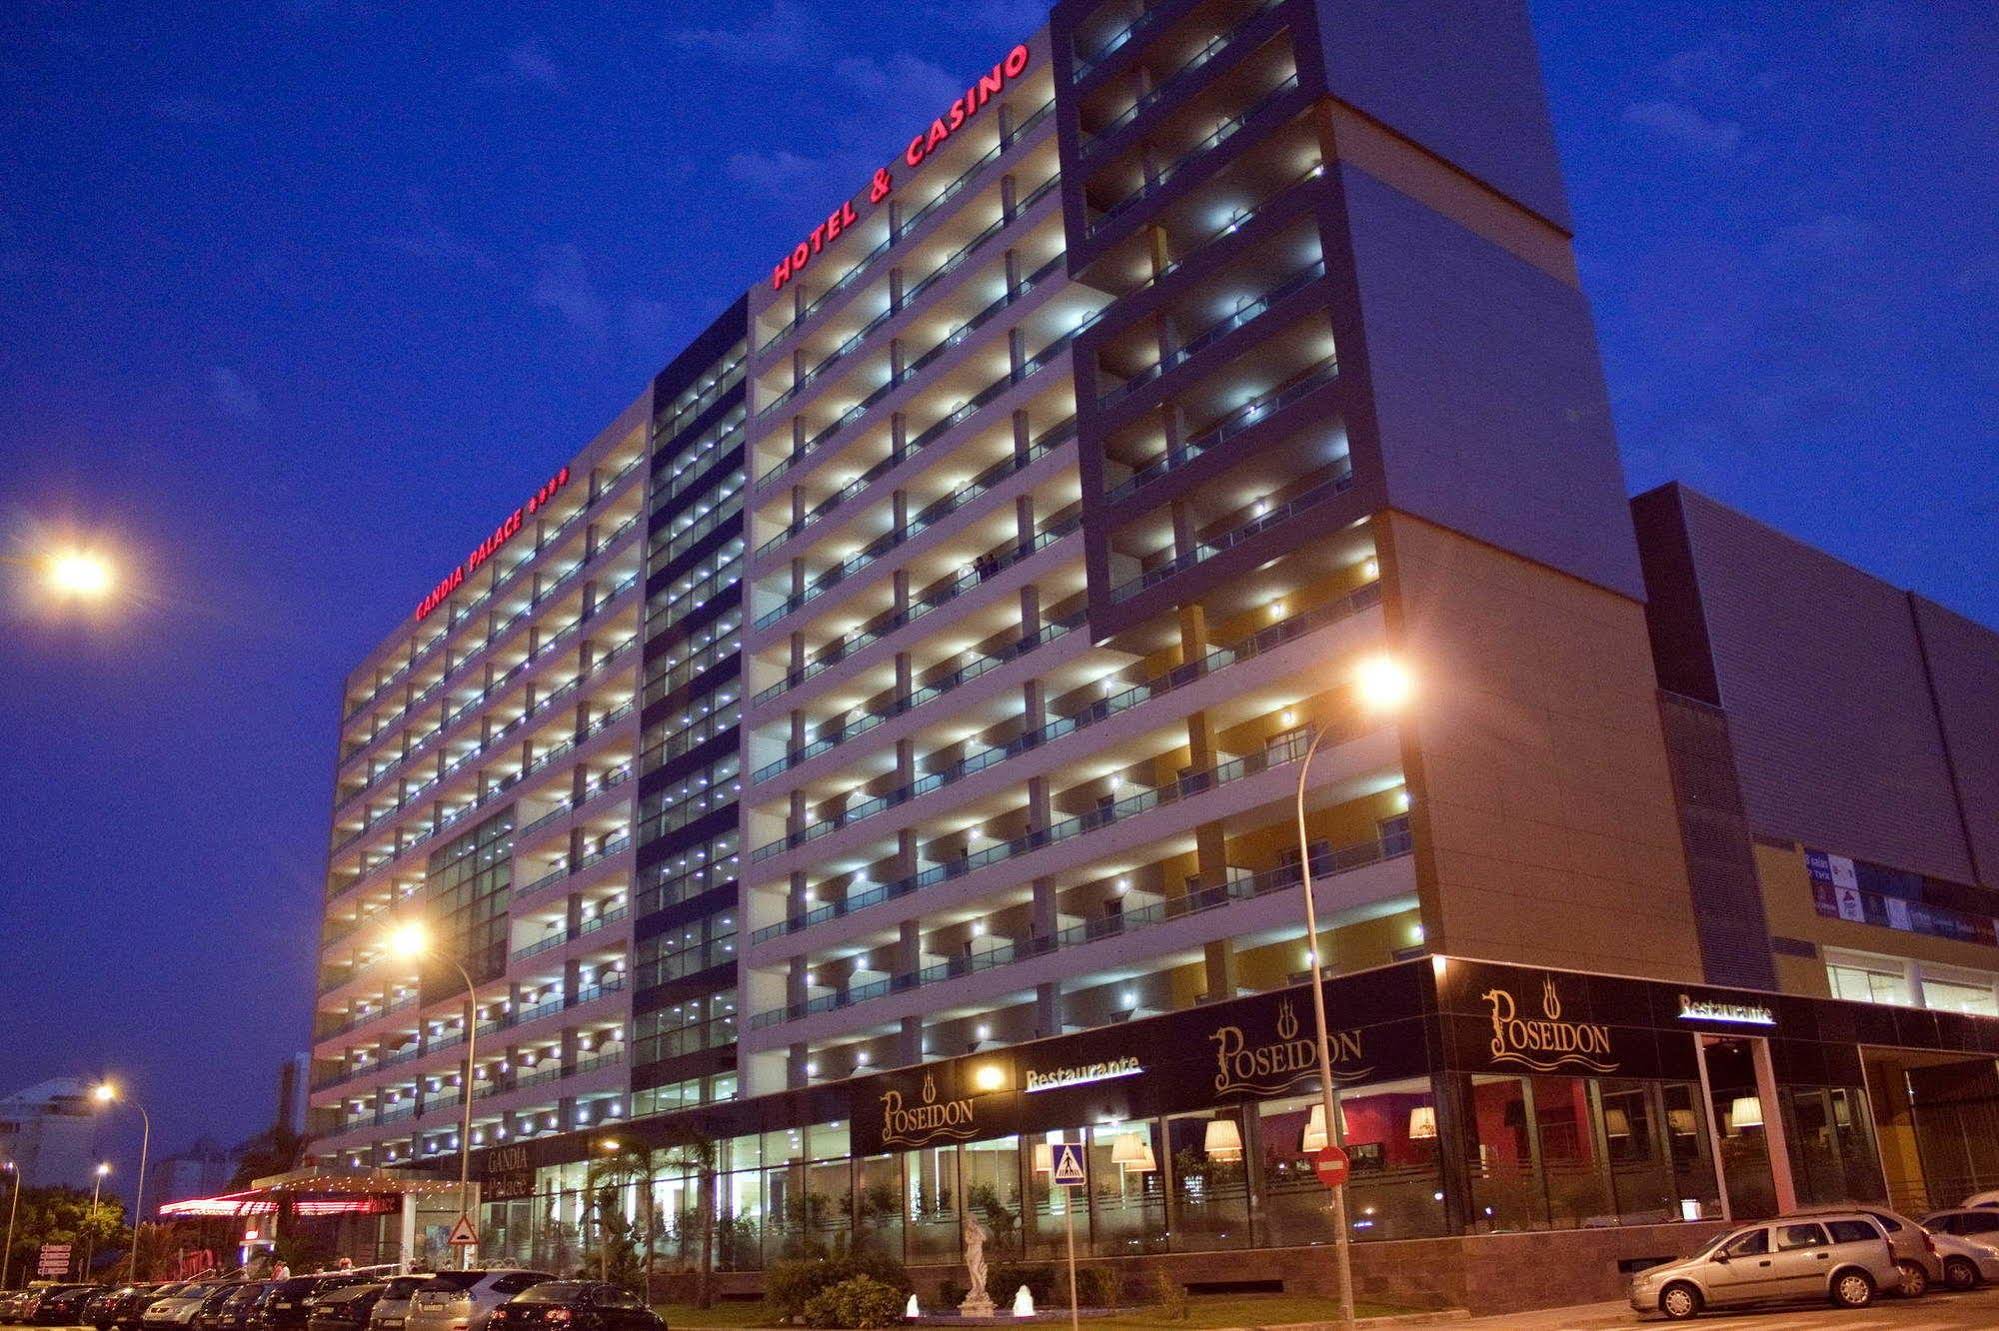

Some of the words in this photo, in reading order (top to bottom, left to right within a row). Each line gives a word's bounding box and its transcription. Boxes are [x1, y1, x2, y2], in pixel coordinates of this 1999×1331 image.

[773, 200, 858, 290] HOTEL
[870, 167, 892, 204] &
[905, 44, 1029, 167] CASINO
[416, 566, 465, 622] GANDIA
[468, 507, 524, 573] PALACE
[1482, 989, 1610, 1056] POSEIDON
[1679, 994, 1773, 1022] Restaurante
[1025, 1056, 1140, 1091] Restaurante
[880, 1090, 974, 1141] POSEIDON
[488, 1147, 528, 1173] GANDIA
